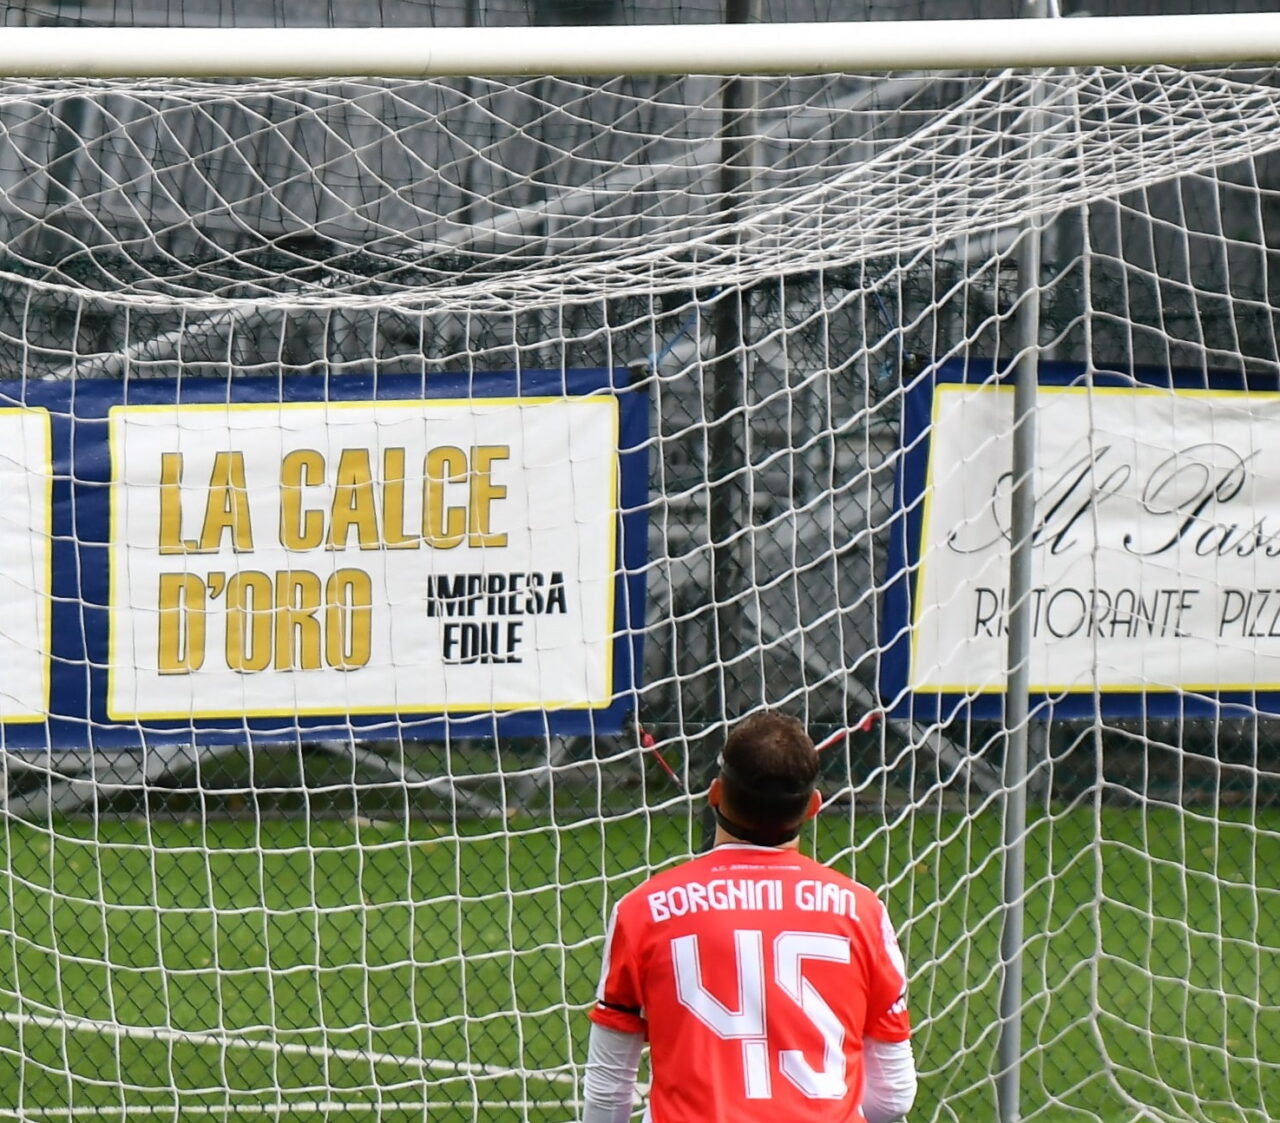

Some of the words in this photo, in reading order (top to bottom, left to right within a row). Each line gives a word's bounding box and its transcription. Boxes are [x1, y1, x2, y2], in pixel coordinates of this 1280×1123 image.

[158, 451, 254, 555] LA
[279, 445, 510, 553] CALCE
[426, 572, 568, 618] IMPRESA
[973, 587, 1201, 639] RITORANTE
[442, 621, 524, 666] EDILE
[647, 878, 783, 924] BORGHINI
[794, 879, 860, 922] GIAN
[670, 929, 852, 1100] 45
